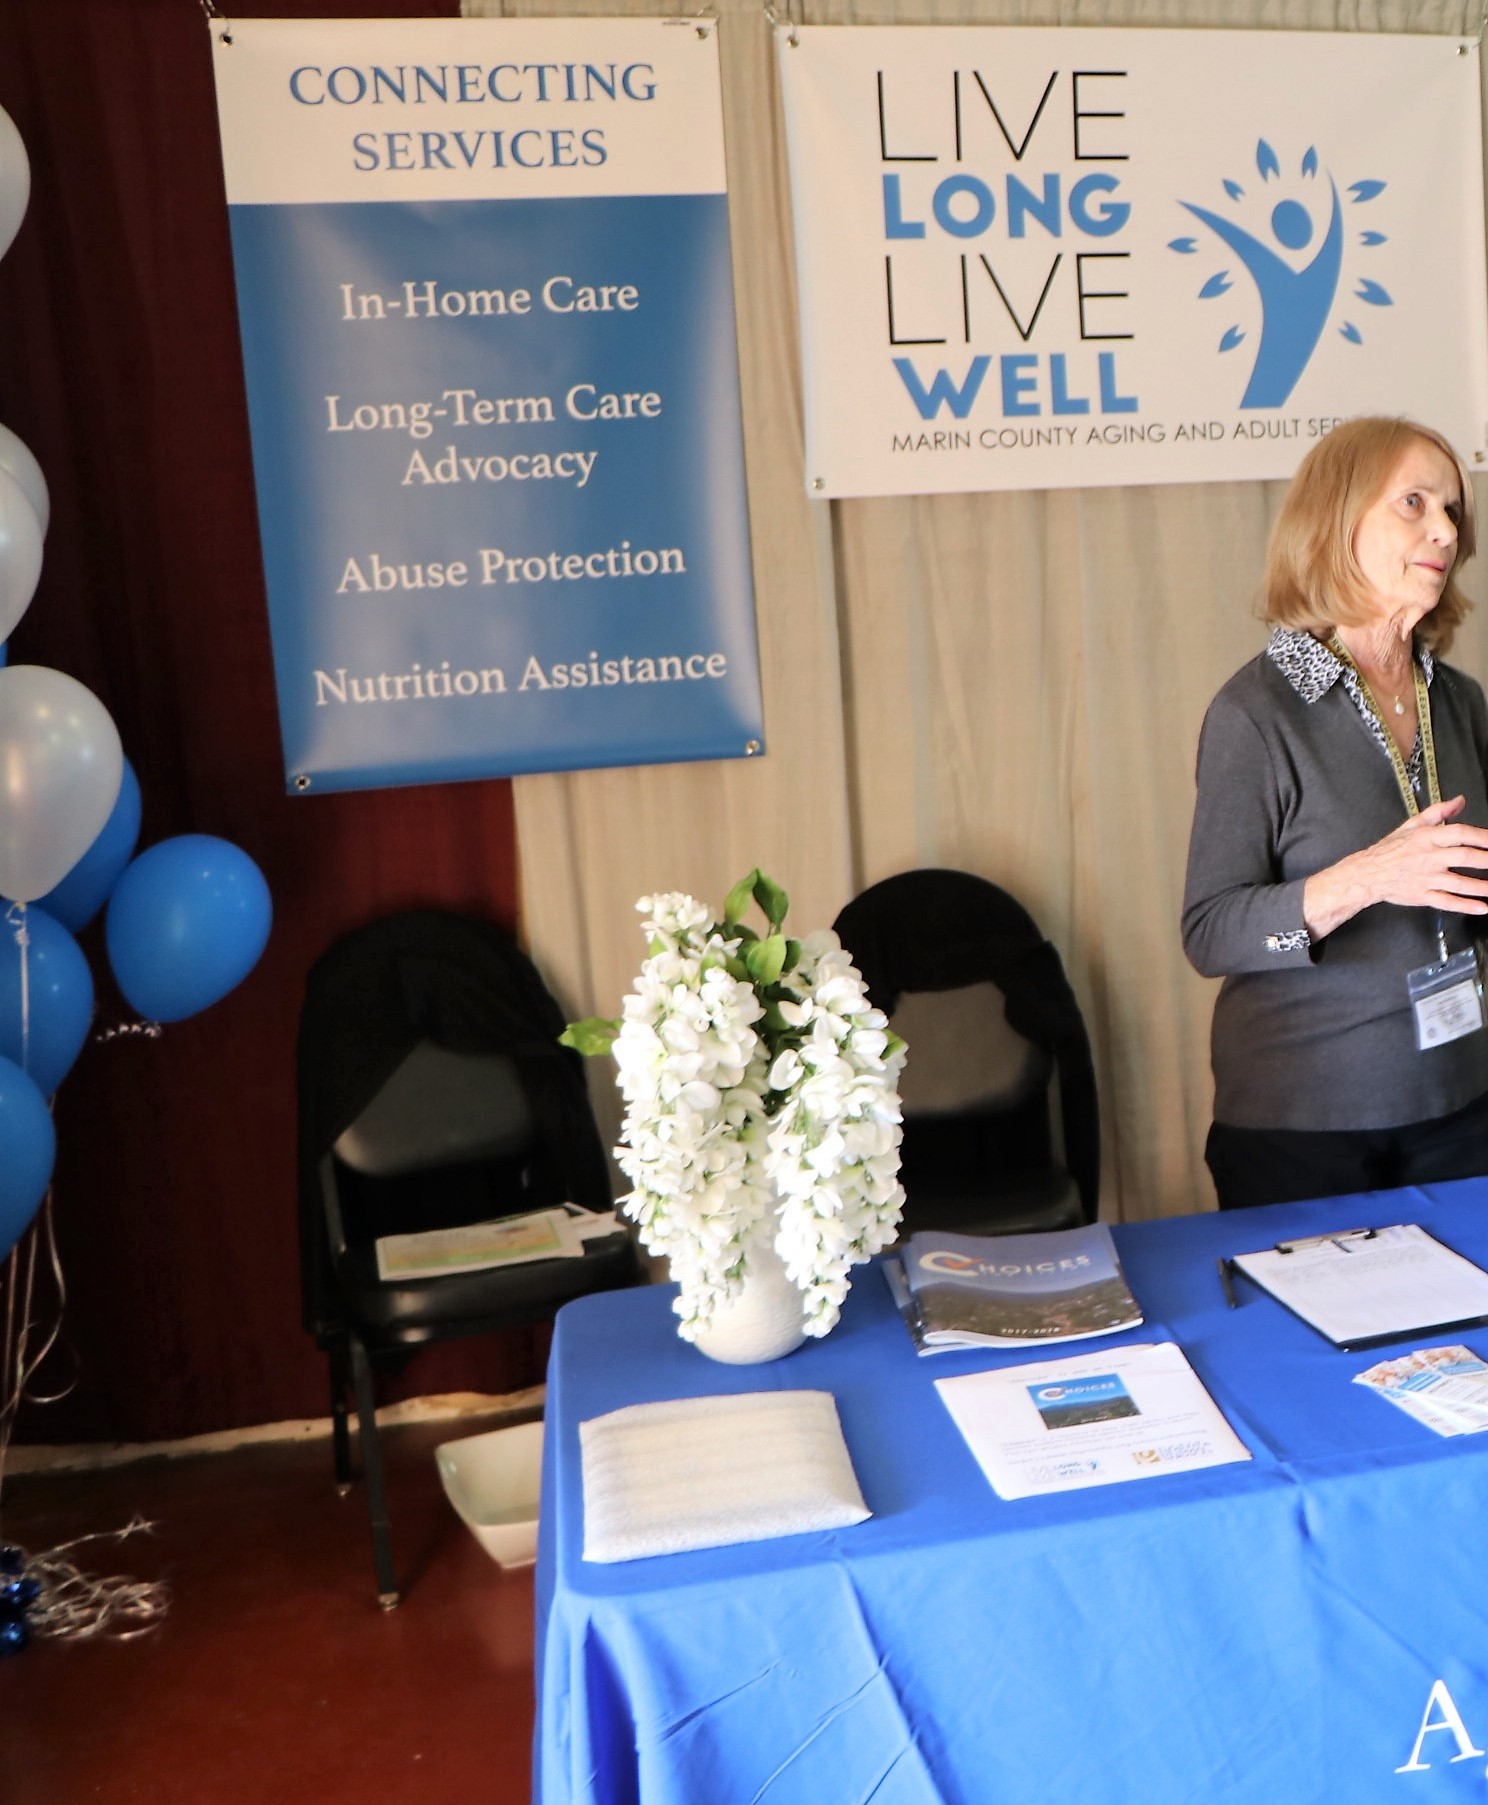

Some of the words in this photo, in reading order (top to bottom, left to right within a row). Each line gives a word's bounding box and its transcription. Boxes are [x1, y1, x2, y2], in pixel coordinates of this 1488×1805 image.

[289, 63, 657, 105] CONNECTING
[877, 69, 1130, 162] LIVE
[354, 129, 608, 171] SERVICES
[882, 172, 1131, 239] LONG
[340, 279, 531, 322] In-Home
[542, 277, 639, 314] Care
[885, 251, 1134, 345] LIVE
[891, 351, 1139, 420] WELL
[325, 389, 555, 437] Long-Term
[567, 384, 663, 420] Care
[892, 429, 971, 453] MARIN
[979, 426, 1079, 450] COUNTY
[1087, 423, 1166, 445] AGING
[1173, 421, 1224, 441] AND
[1233, 419, 1302, 440] ADULT
[402, 446, 598, 488] Advocacy
[336, 553, 468, 594] Abuse
[480, 541, 687, 585] Protection
[314, 660, 508, 705] Nutrition
[519, 651, 728, 692] Assistance
[919, 1251, 1091, 1276] CHOICES
[1037, 1381, 1117, 1401] CHOICES
